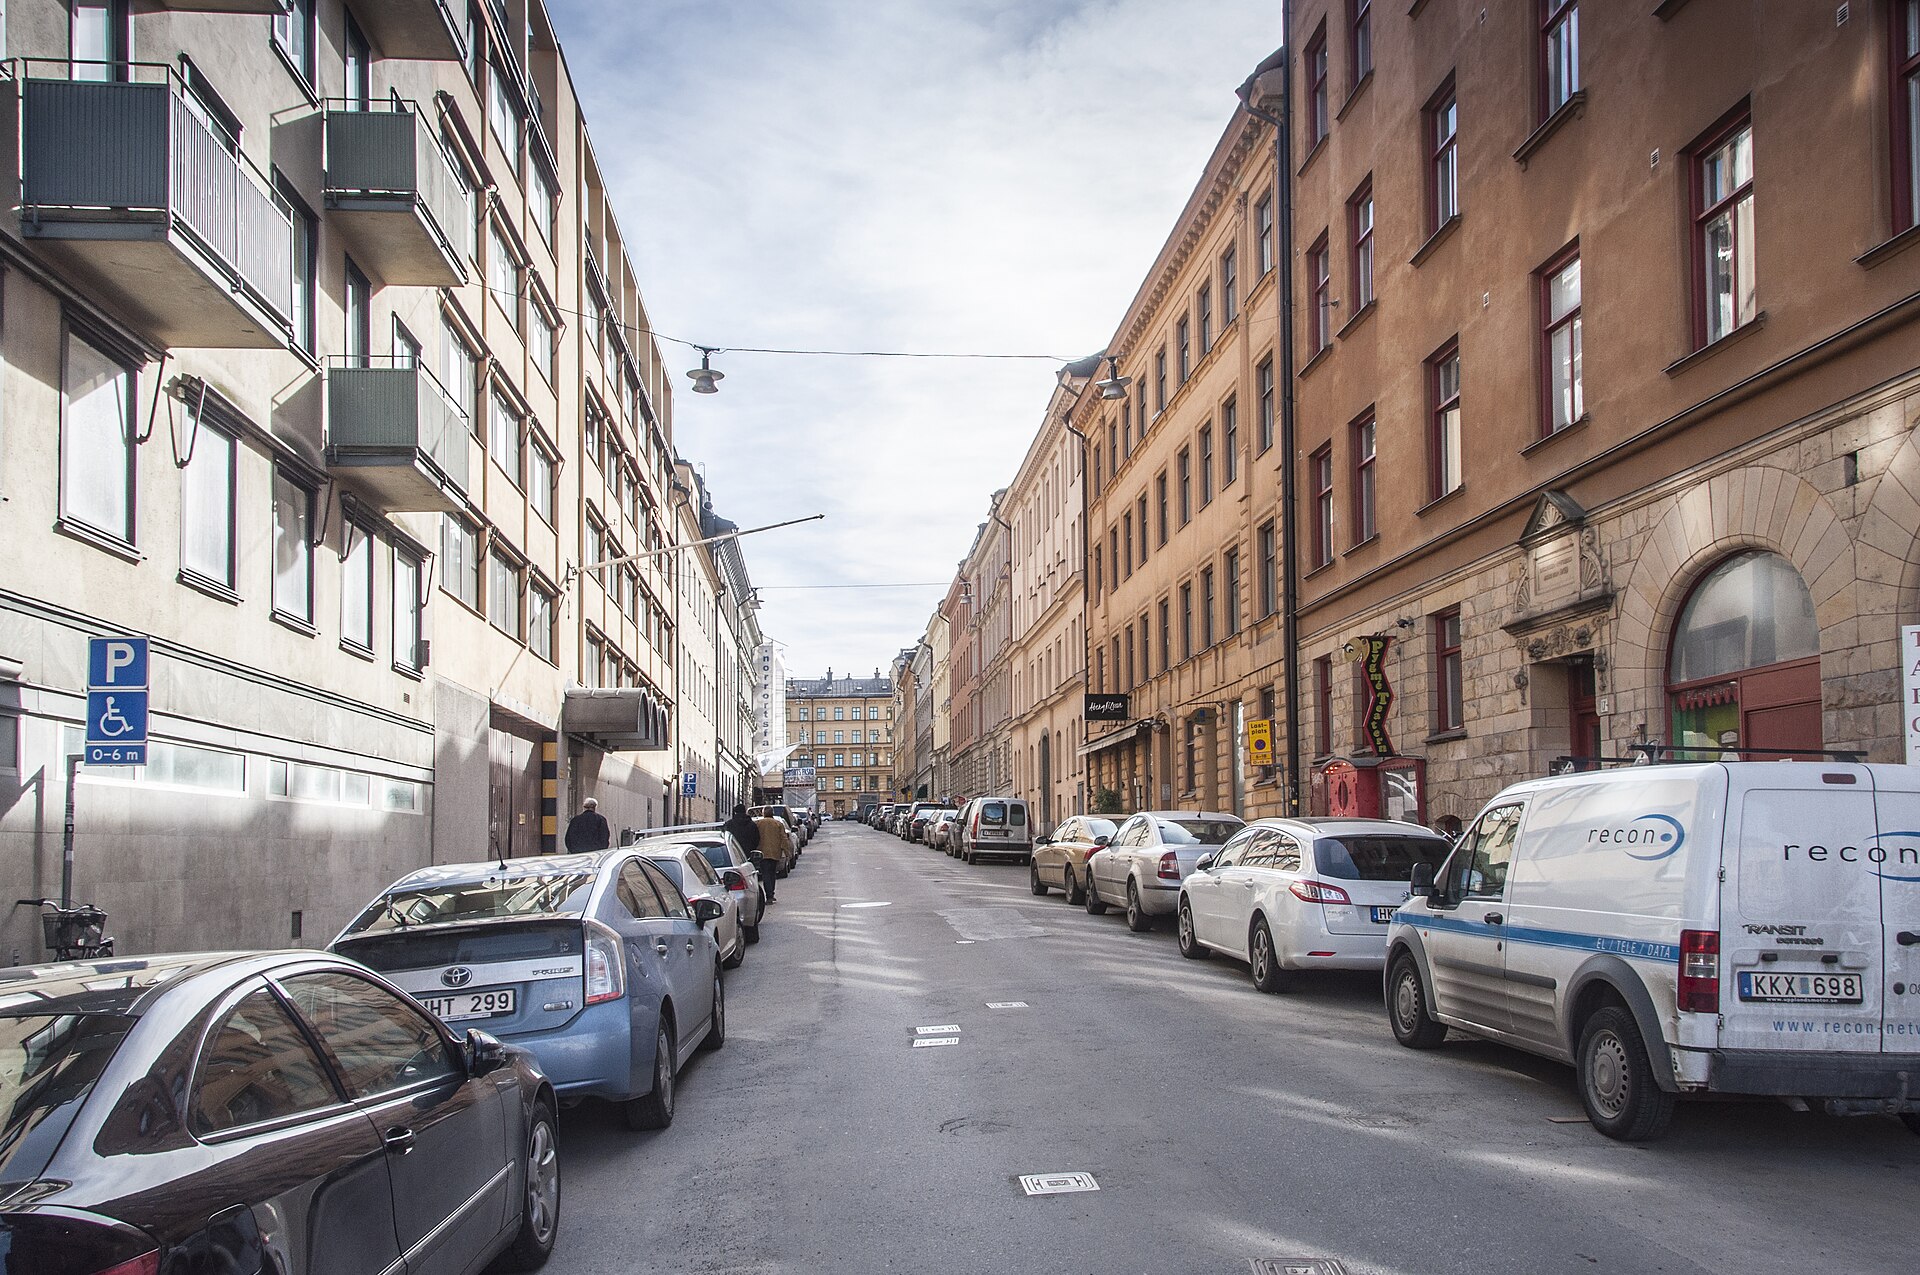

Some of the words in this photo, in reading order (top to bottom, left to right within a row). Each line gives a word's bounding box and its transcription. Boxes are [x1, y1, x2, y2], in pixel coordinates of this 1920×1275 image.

[106, 642, 135, 682] P
[92, 749, 121, 761] 0-6
[126, 751, 138, 761] m
[688, 774, 694, 782] P
[1588, 829, 1655, 843] recon
[1784, 845, 1918, 864] recon
[1379, 908, 1397, 920] HK
[1742, 923, 1807, 936] TRANSIT
[1596, 938, 1606, 950] EL
[1616, 940, 1637, 954] TELE
[1647, 944, 1671, 958] DATA
[1754, 976, 1797, 996] KKX
[1813, 977, 1856, 997] 698
[470, 992, 510, 1013] 299
